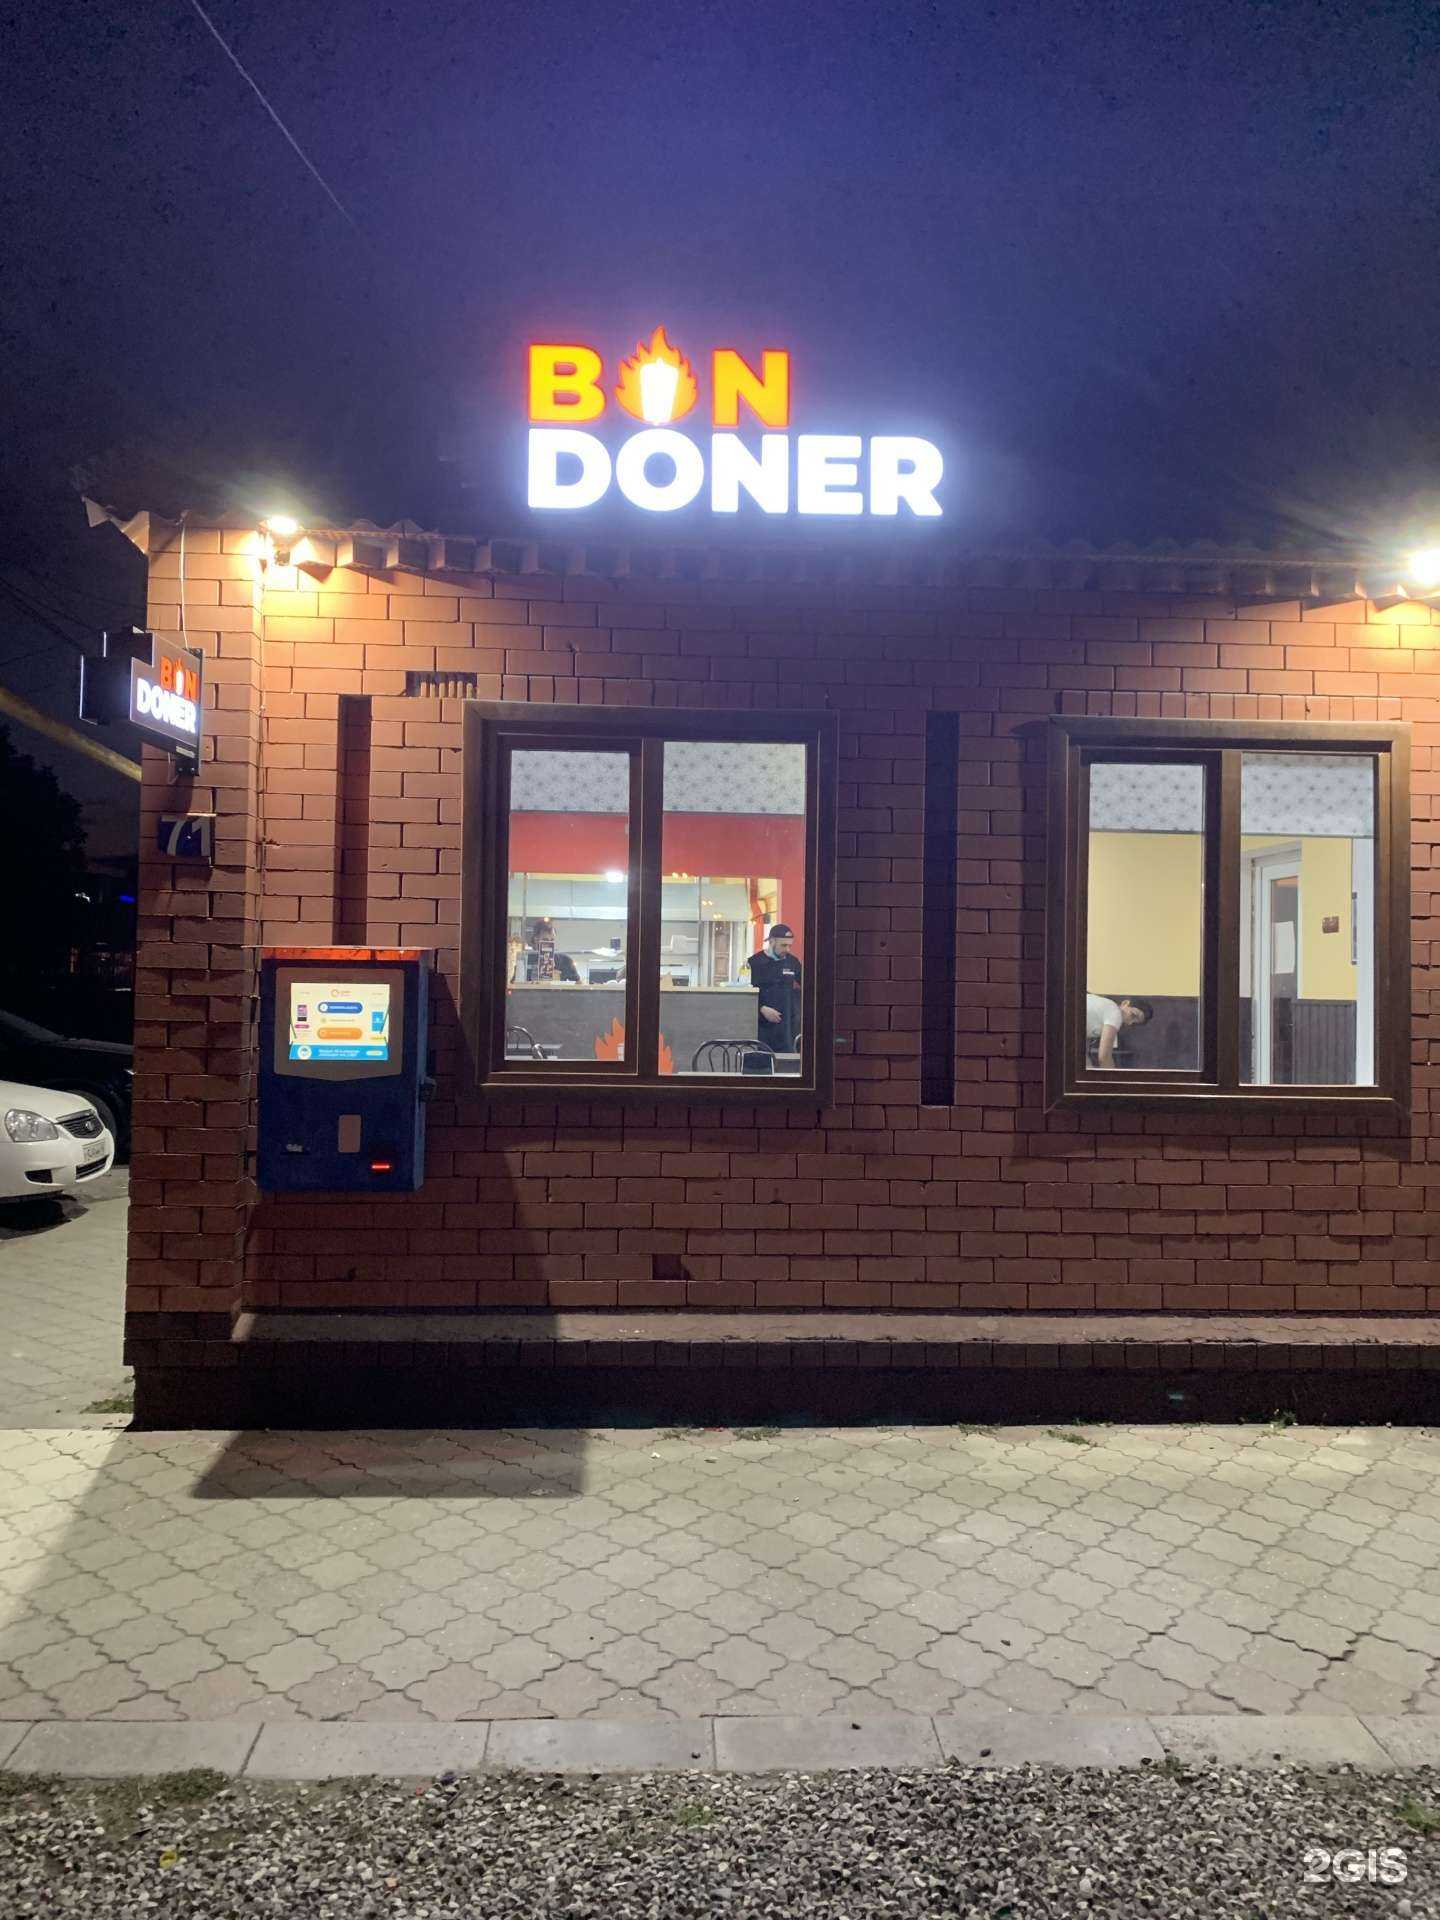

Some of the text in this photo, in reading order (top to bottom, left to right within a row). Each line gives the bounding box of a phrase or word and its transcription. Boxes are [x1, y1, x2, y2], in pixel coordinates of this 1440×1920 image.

[528, 428, 944, 517] DONER
[136, 677, 196, 734] DONER
[161, 815, 211, 857] 71
